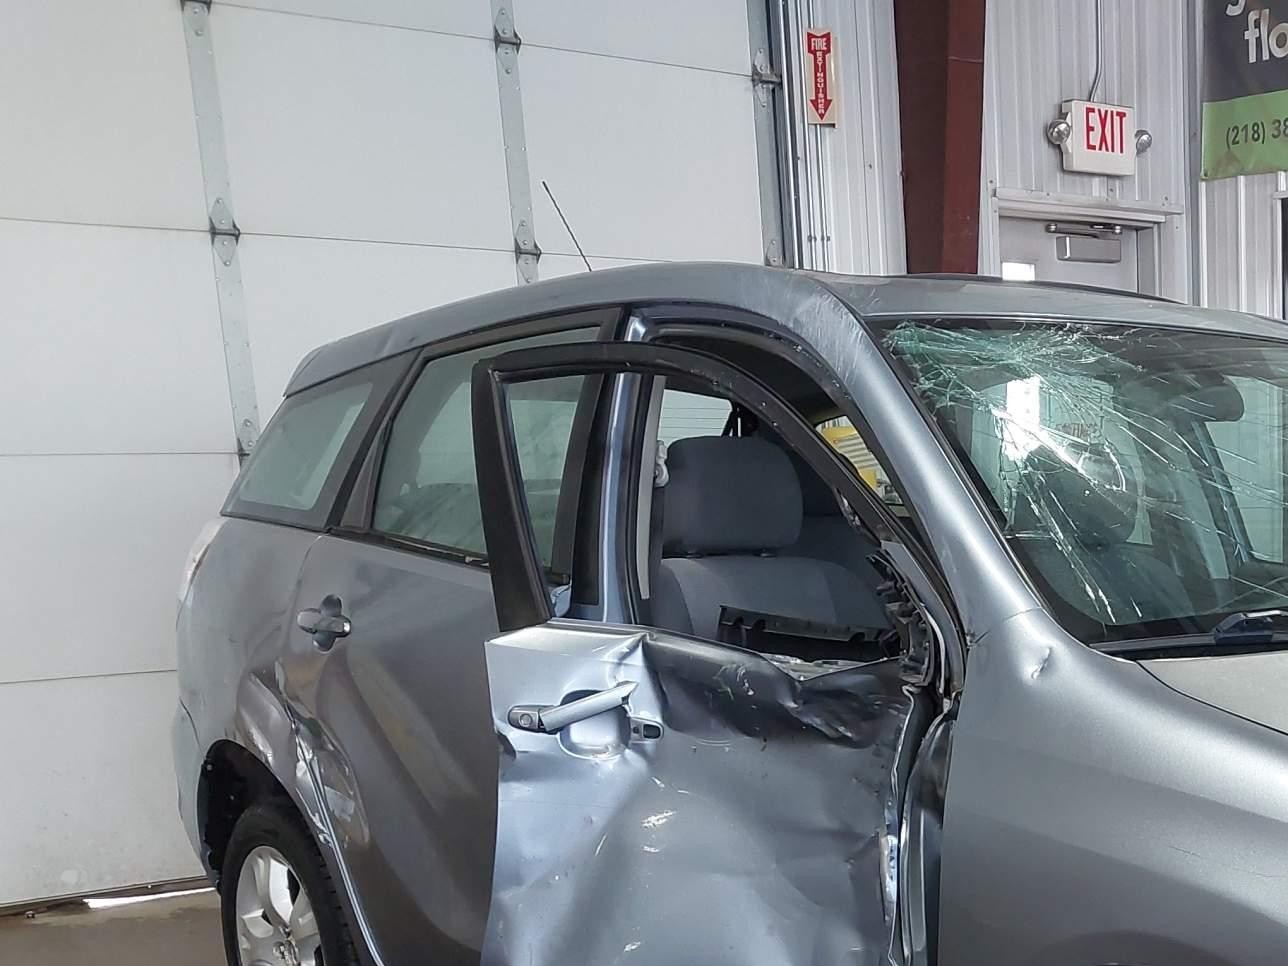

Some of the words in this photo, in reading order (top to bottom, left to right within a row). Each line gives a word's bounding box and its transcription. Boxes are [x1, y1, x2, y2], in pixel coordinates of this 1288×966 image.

[811, 37, 827, 51] FIRE
[816, 51, 825, 114] EXTINGUISHER
[1085, 106, 1127, 154] EXIT
[1226, 120, 1266, 149] (218)
